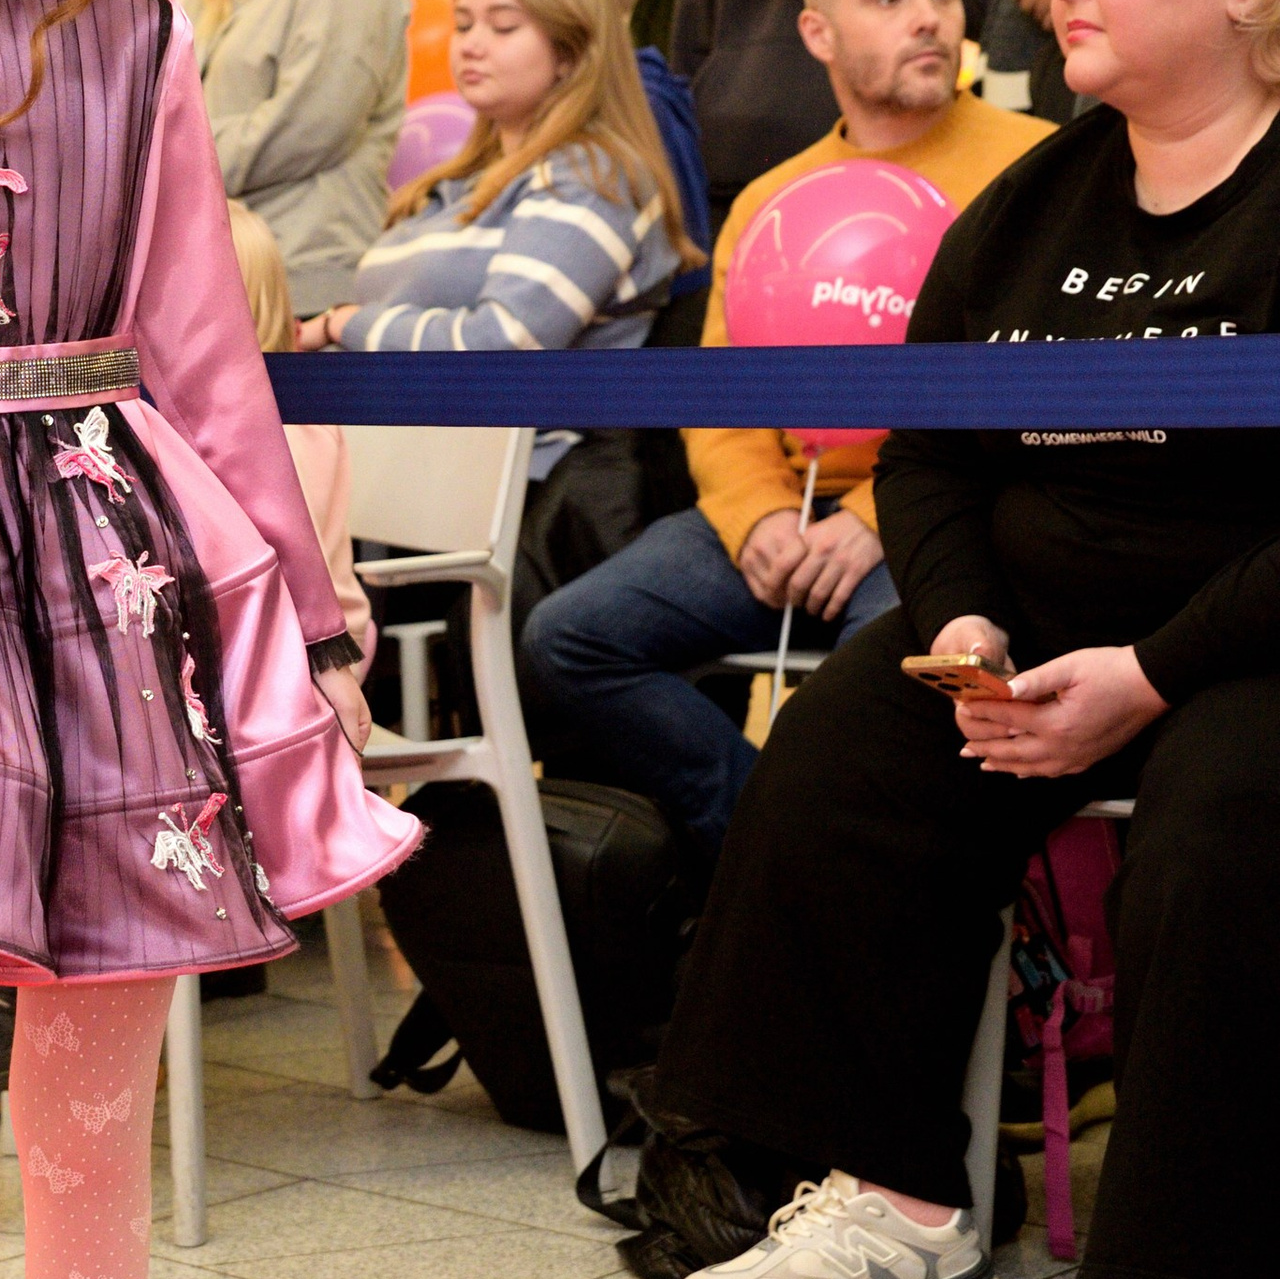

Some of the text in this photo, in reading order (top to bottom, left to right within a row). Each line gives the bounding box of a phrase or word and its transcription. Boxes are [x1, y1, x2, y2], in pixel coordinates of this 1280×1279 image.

[1060, 267, 1205, 301] BEGIN
[1021, 429, 1167, 445] GO SOMEWHERE WILD
